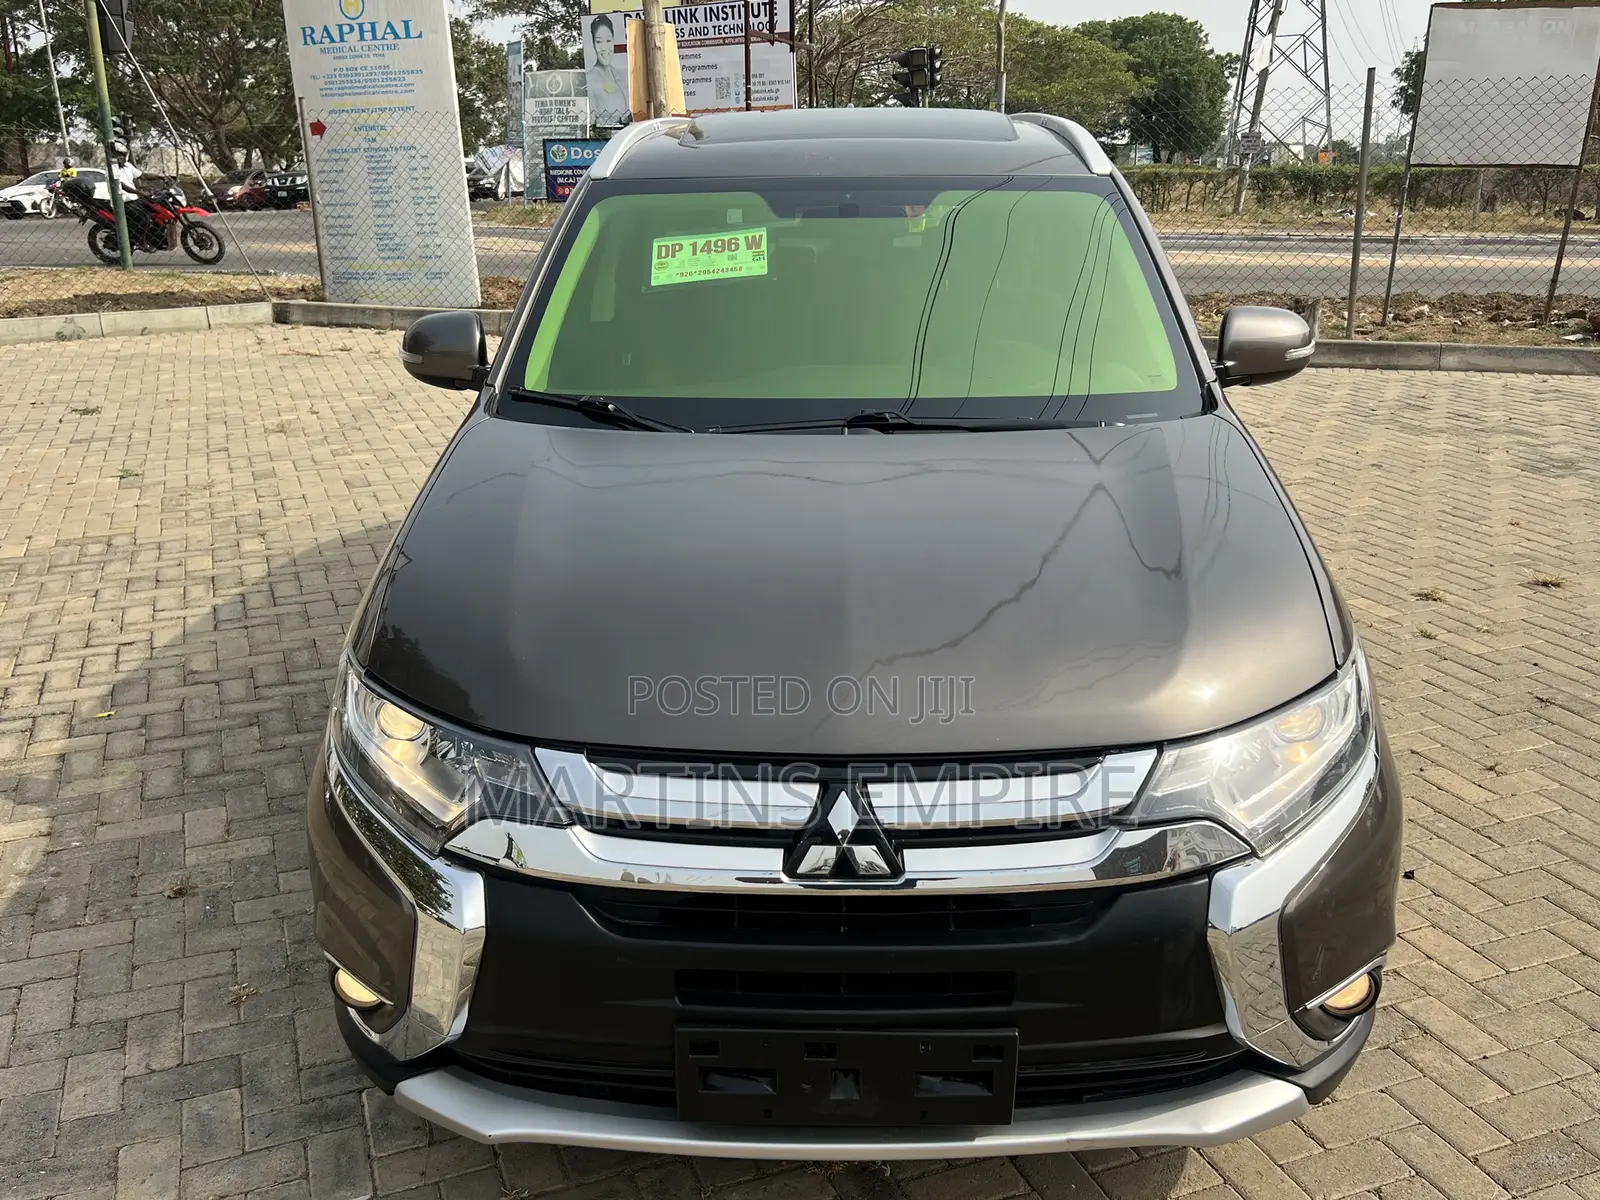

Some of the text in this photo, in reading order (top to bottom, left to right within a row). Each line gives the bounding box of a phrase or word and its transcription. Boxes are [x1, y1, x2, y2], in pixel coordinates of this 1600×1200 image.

[300, 20, 423, 46] RAPHAL
[688, 26, 709, 38] AND
[320, 43, 400, 55] MEDICAL CENTRE
[682, 64, 718, 73] Programmes
[683, 77, 712, 86] ogrammes
[657, 234, 763, 260] DP 1496 W
